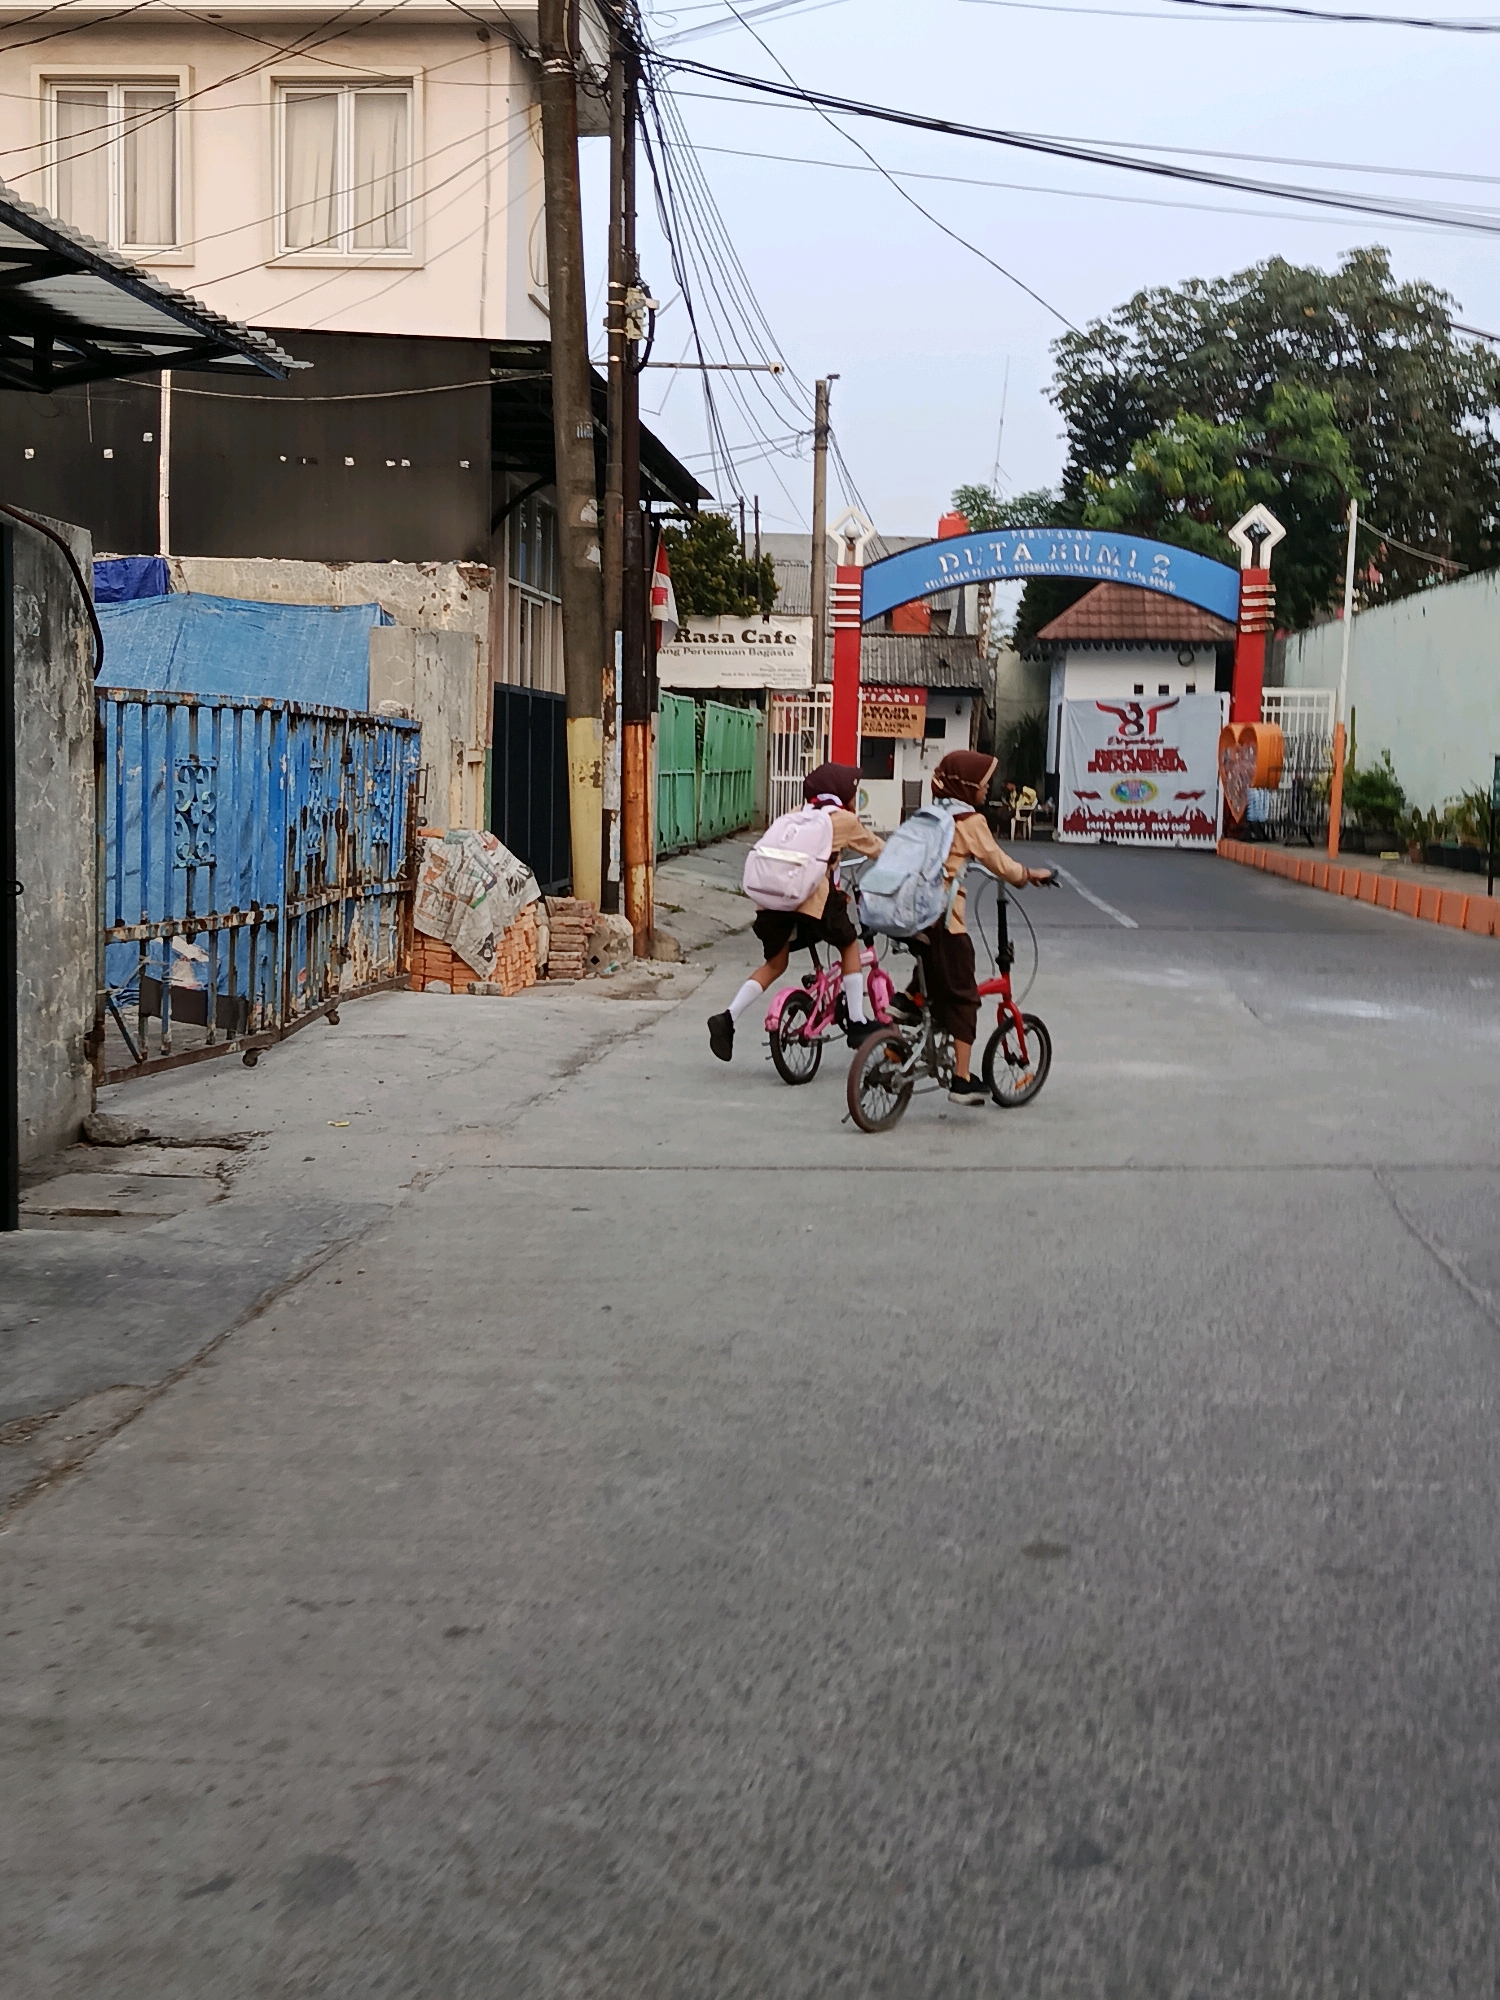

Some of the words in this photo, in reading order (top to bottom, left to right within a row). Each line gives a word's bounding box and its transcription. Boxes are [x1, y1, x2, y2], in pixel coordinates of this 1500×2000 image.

[938, 541, 1033, 573] DUTA
[674, 628, 735, 644] Rasa
[741, 628, 797, 645] Cafe
[659, 648, 681, 657] ang
